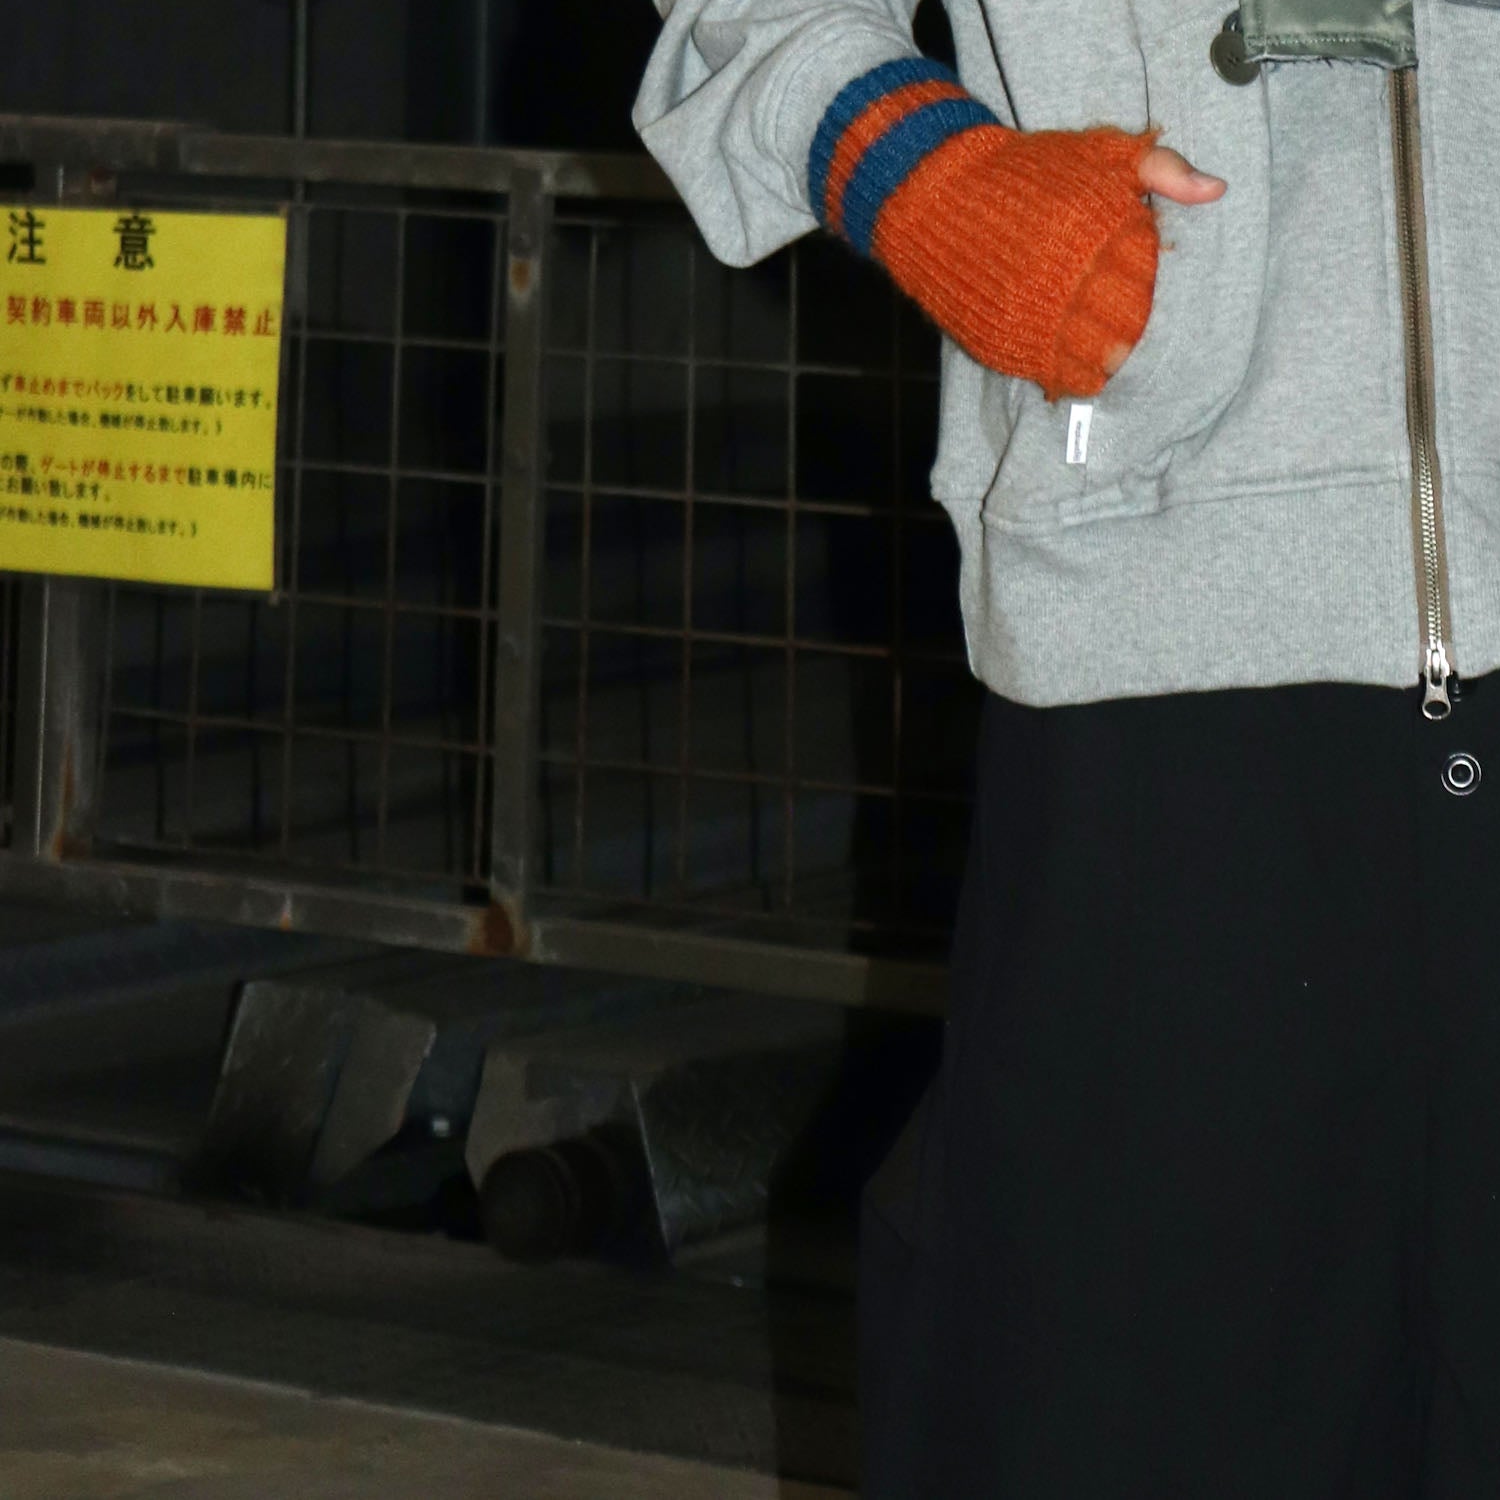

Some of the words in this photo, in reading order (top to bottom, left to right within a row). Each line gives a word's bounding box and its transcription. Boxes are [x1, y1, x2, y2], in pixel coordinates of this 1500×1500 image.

[6, 295, 278, 337] 契約車両以外入庫禁止
